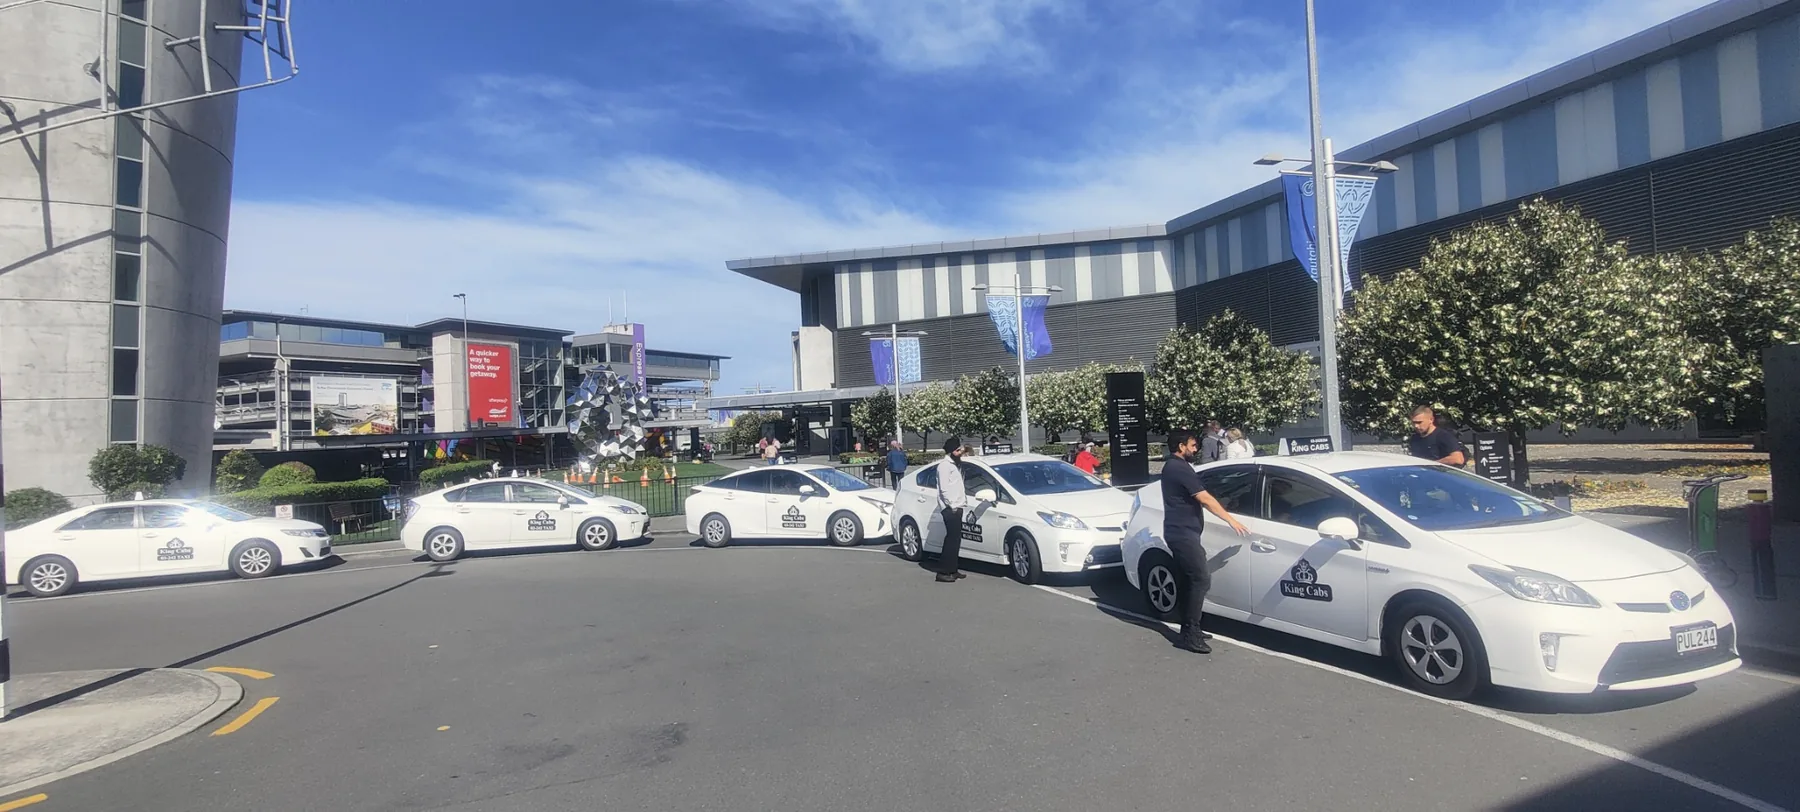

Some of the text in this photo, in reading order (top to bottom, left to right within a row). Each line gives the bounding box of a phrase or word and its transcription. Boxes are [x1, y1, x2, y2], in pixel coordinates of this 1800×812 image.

[475, 349, 499, 357] quicker
[1291, 443, 1329, 452] KING CABS
[1284, 583, 1329, 598] King Cabs
[1677, 629, 1715, 650] PUL244
